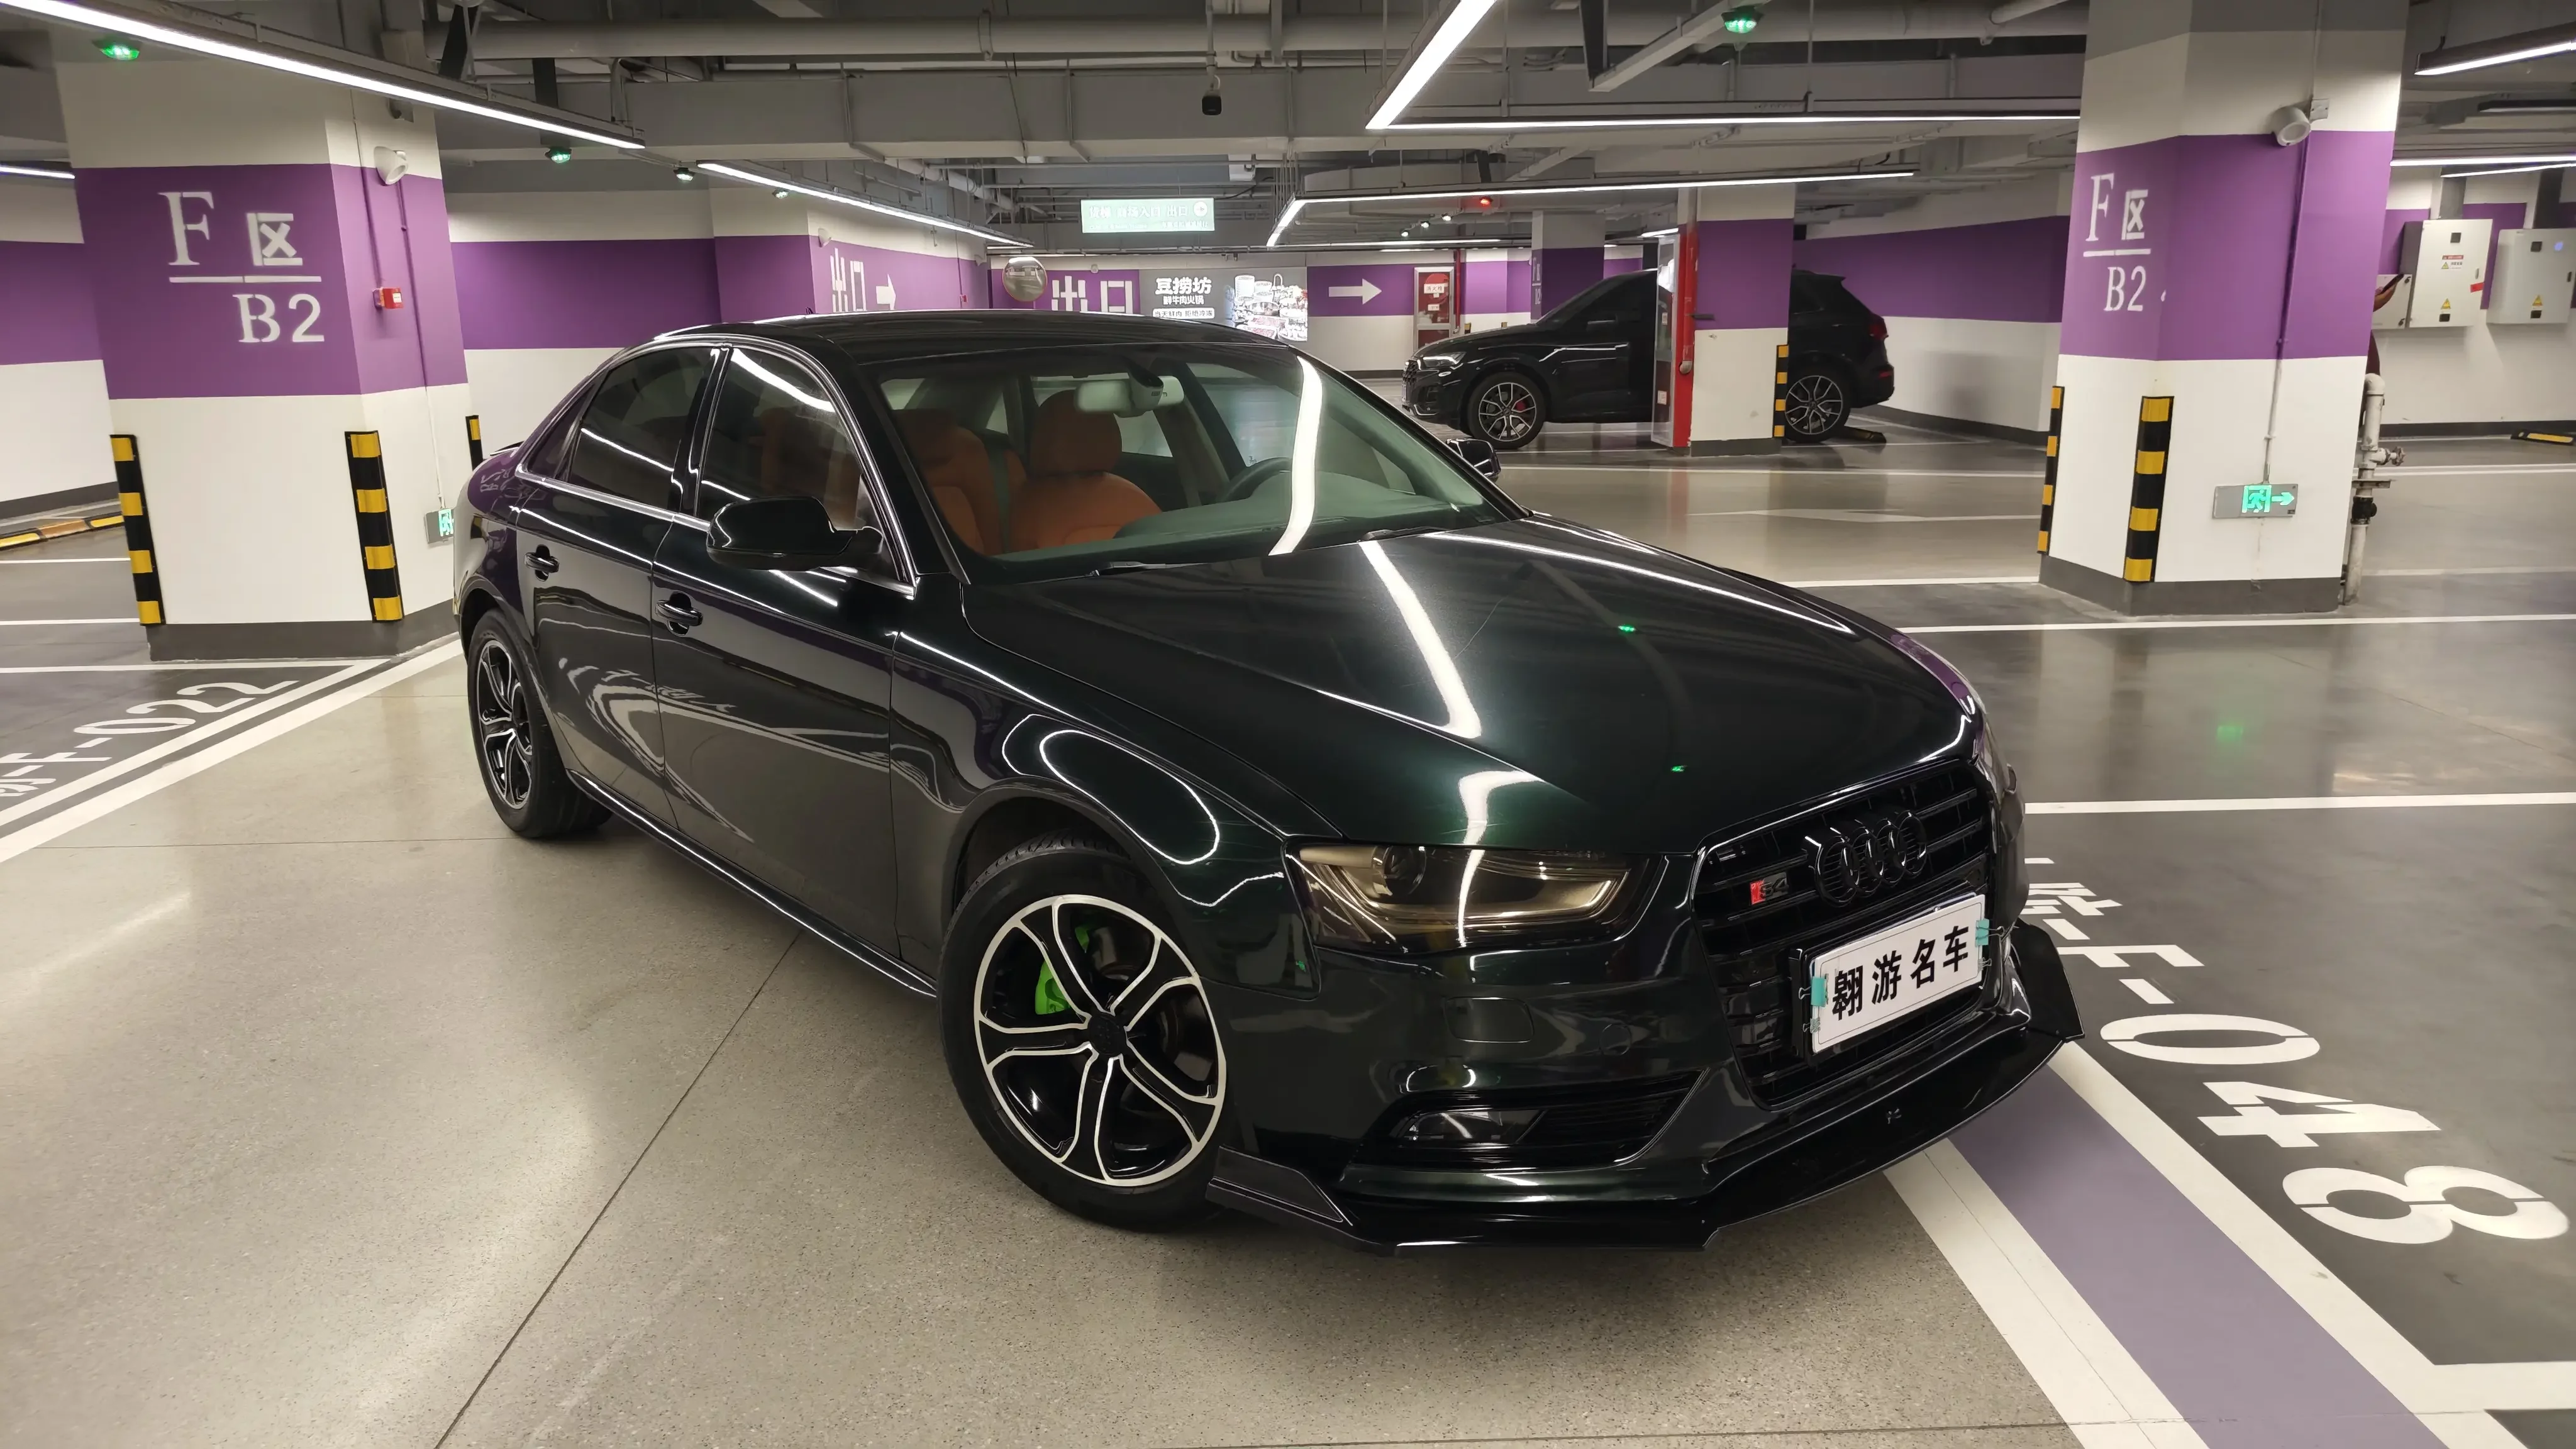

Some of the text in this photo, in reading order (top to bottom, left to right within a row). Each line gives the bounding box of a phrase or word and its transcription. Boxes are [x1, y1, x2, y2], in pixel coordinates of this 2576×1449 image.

[1167, 205, 1189, 217] 出口
[830, 248, 867, 313] 出口
[1052, 275, 1133, 314] 出口
[1155, 277, 1212, 295] 豆捞坊
[2104, 265, 2146, 312] B2
[232, 293, 325, 343] B2
[1832, 925, 1969, 1021] 翱游名车
